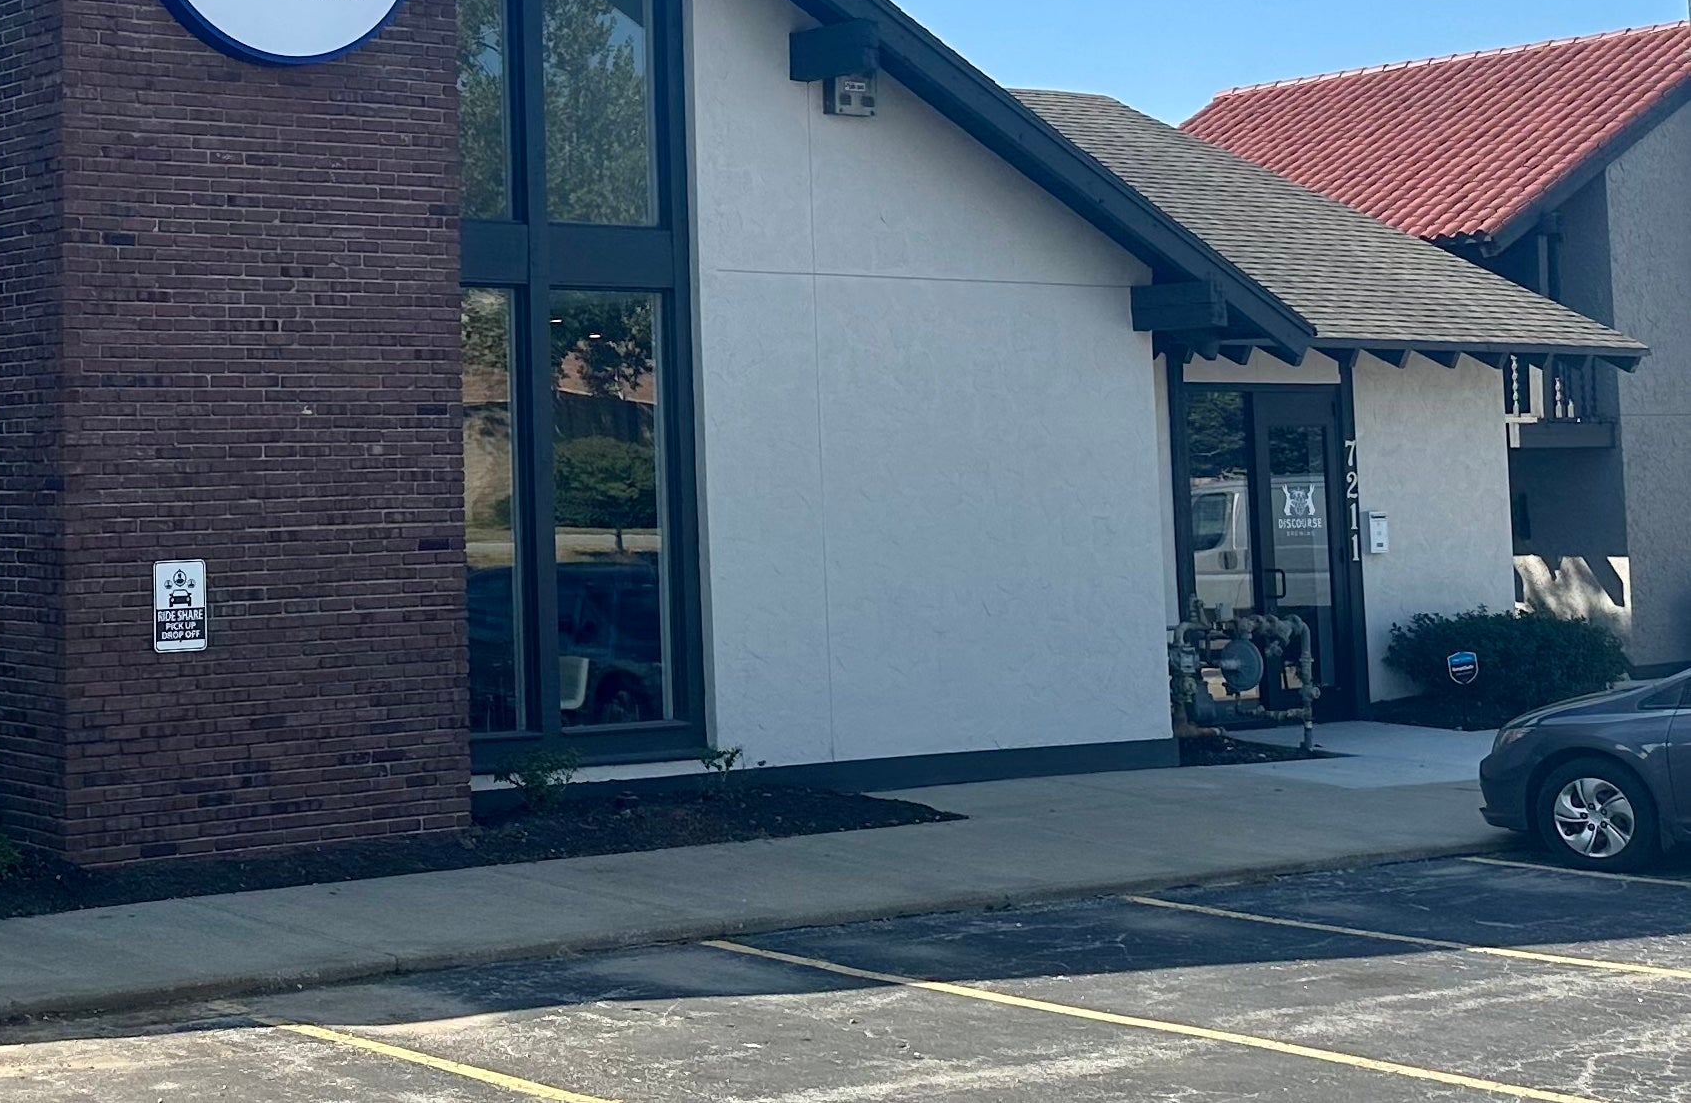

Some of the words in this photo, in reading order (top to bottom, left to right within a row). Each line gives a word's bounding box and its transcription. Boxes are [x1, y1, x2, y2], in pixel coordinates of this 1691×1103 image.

[1344, 440, 1360, 562] 7211
[1278, 517, 1322, 529] DISCOURSE
[157, 610, 176, 623] RIDE
[177, 609, 204, 622] SHARE
[165, 622, 184, 630] PICK
[185, 621, 197, 629] UP
[161, 631, 184, 640] DROP
[185, 630, 201, 639] OFF
